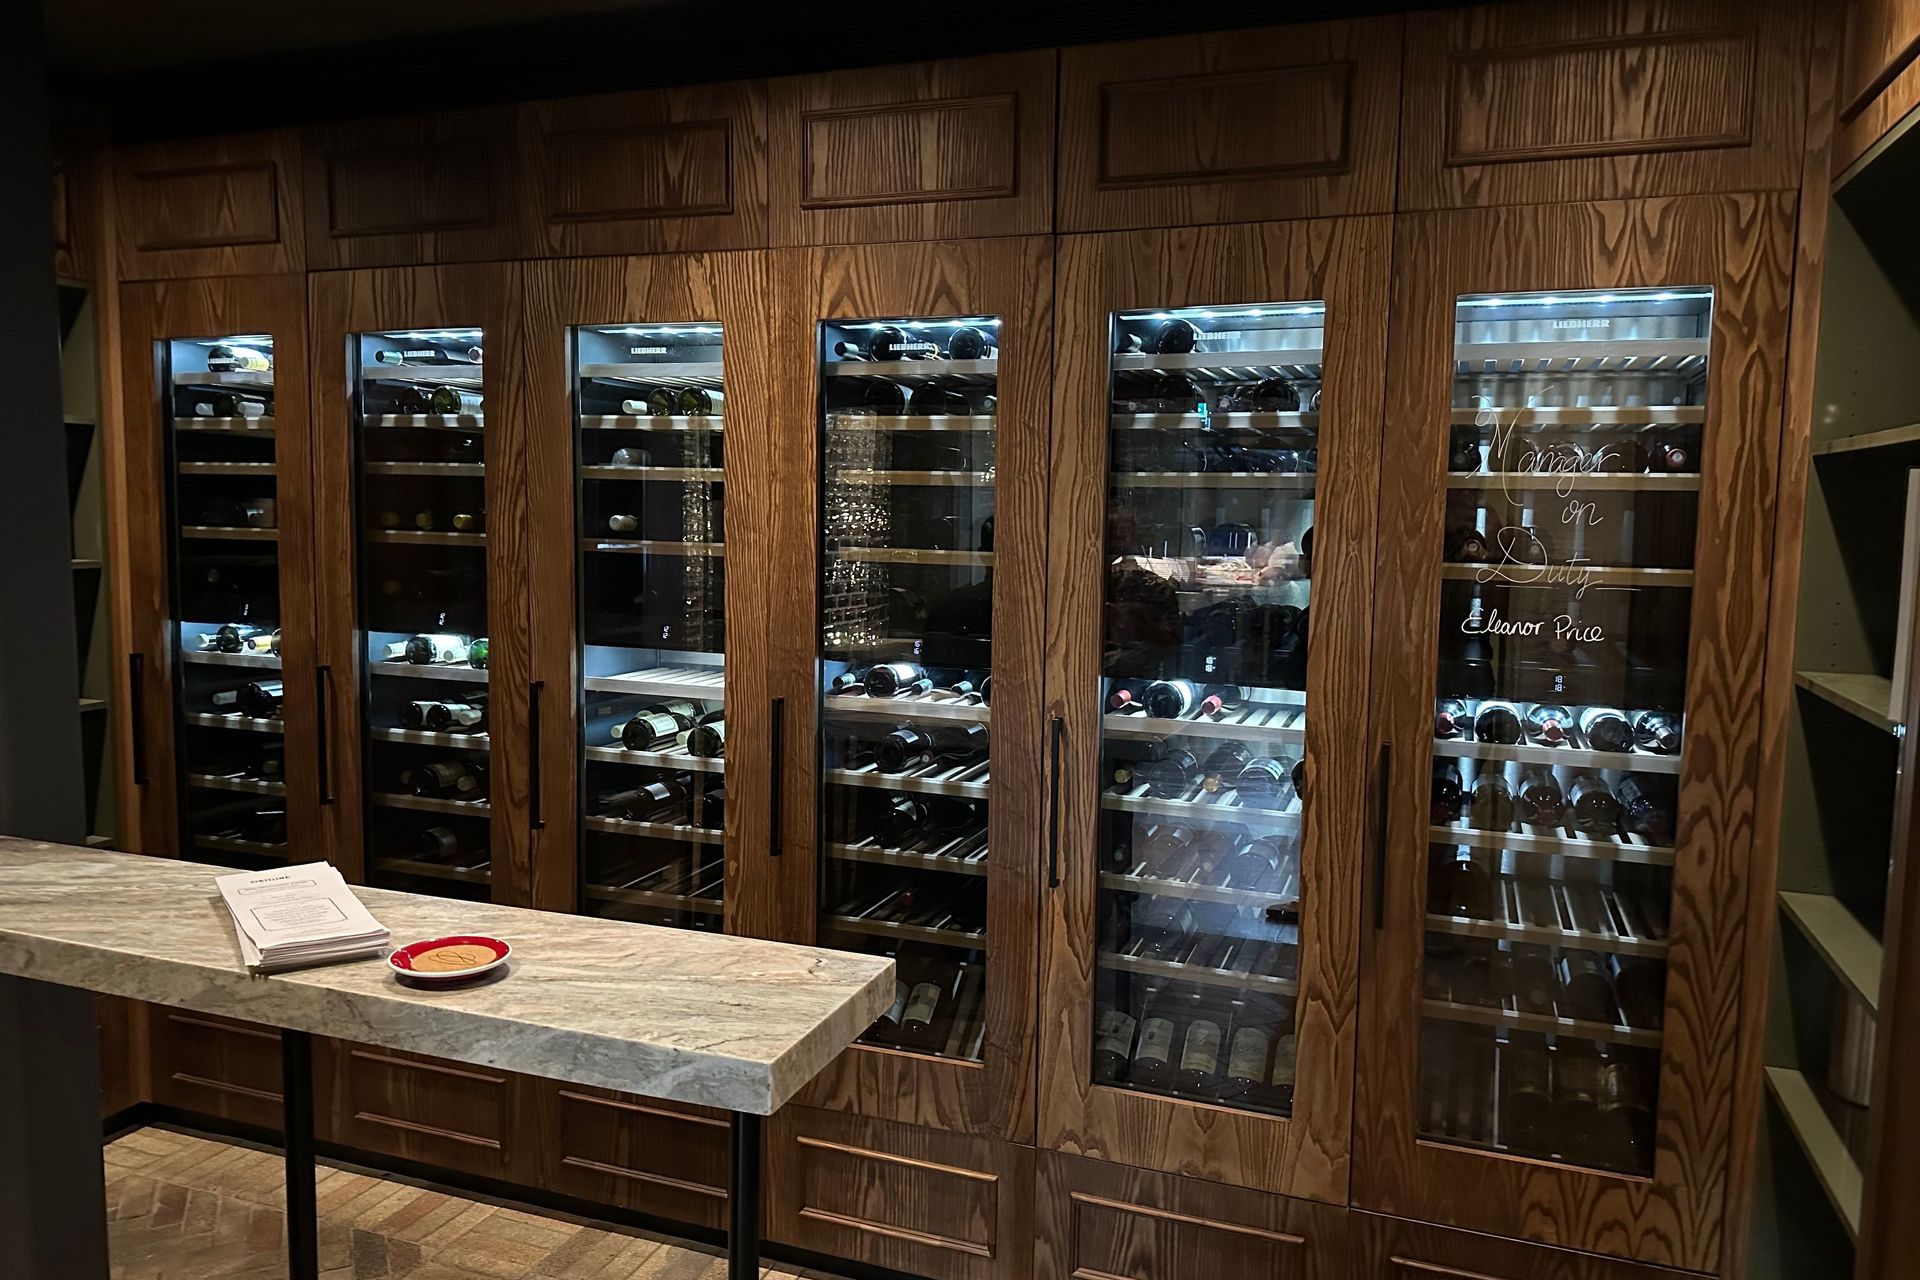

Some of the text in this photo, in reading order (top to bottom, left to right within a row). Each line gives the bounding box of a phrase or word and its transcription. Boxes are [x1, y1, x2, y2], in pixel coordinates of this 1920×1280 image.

[1552, 319, 1610, 329] LIEBHERR
[1465, 385, 1621, 507] Manager
[1561, 499, 1604, 526] on
[1475, 526, 1604, 600] Duty
[1461, 608, 1605, 642] Eleanor Price
